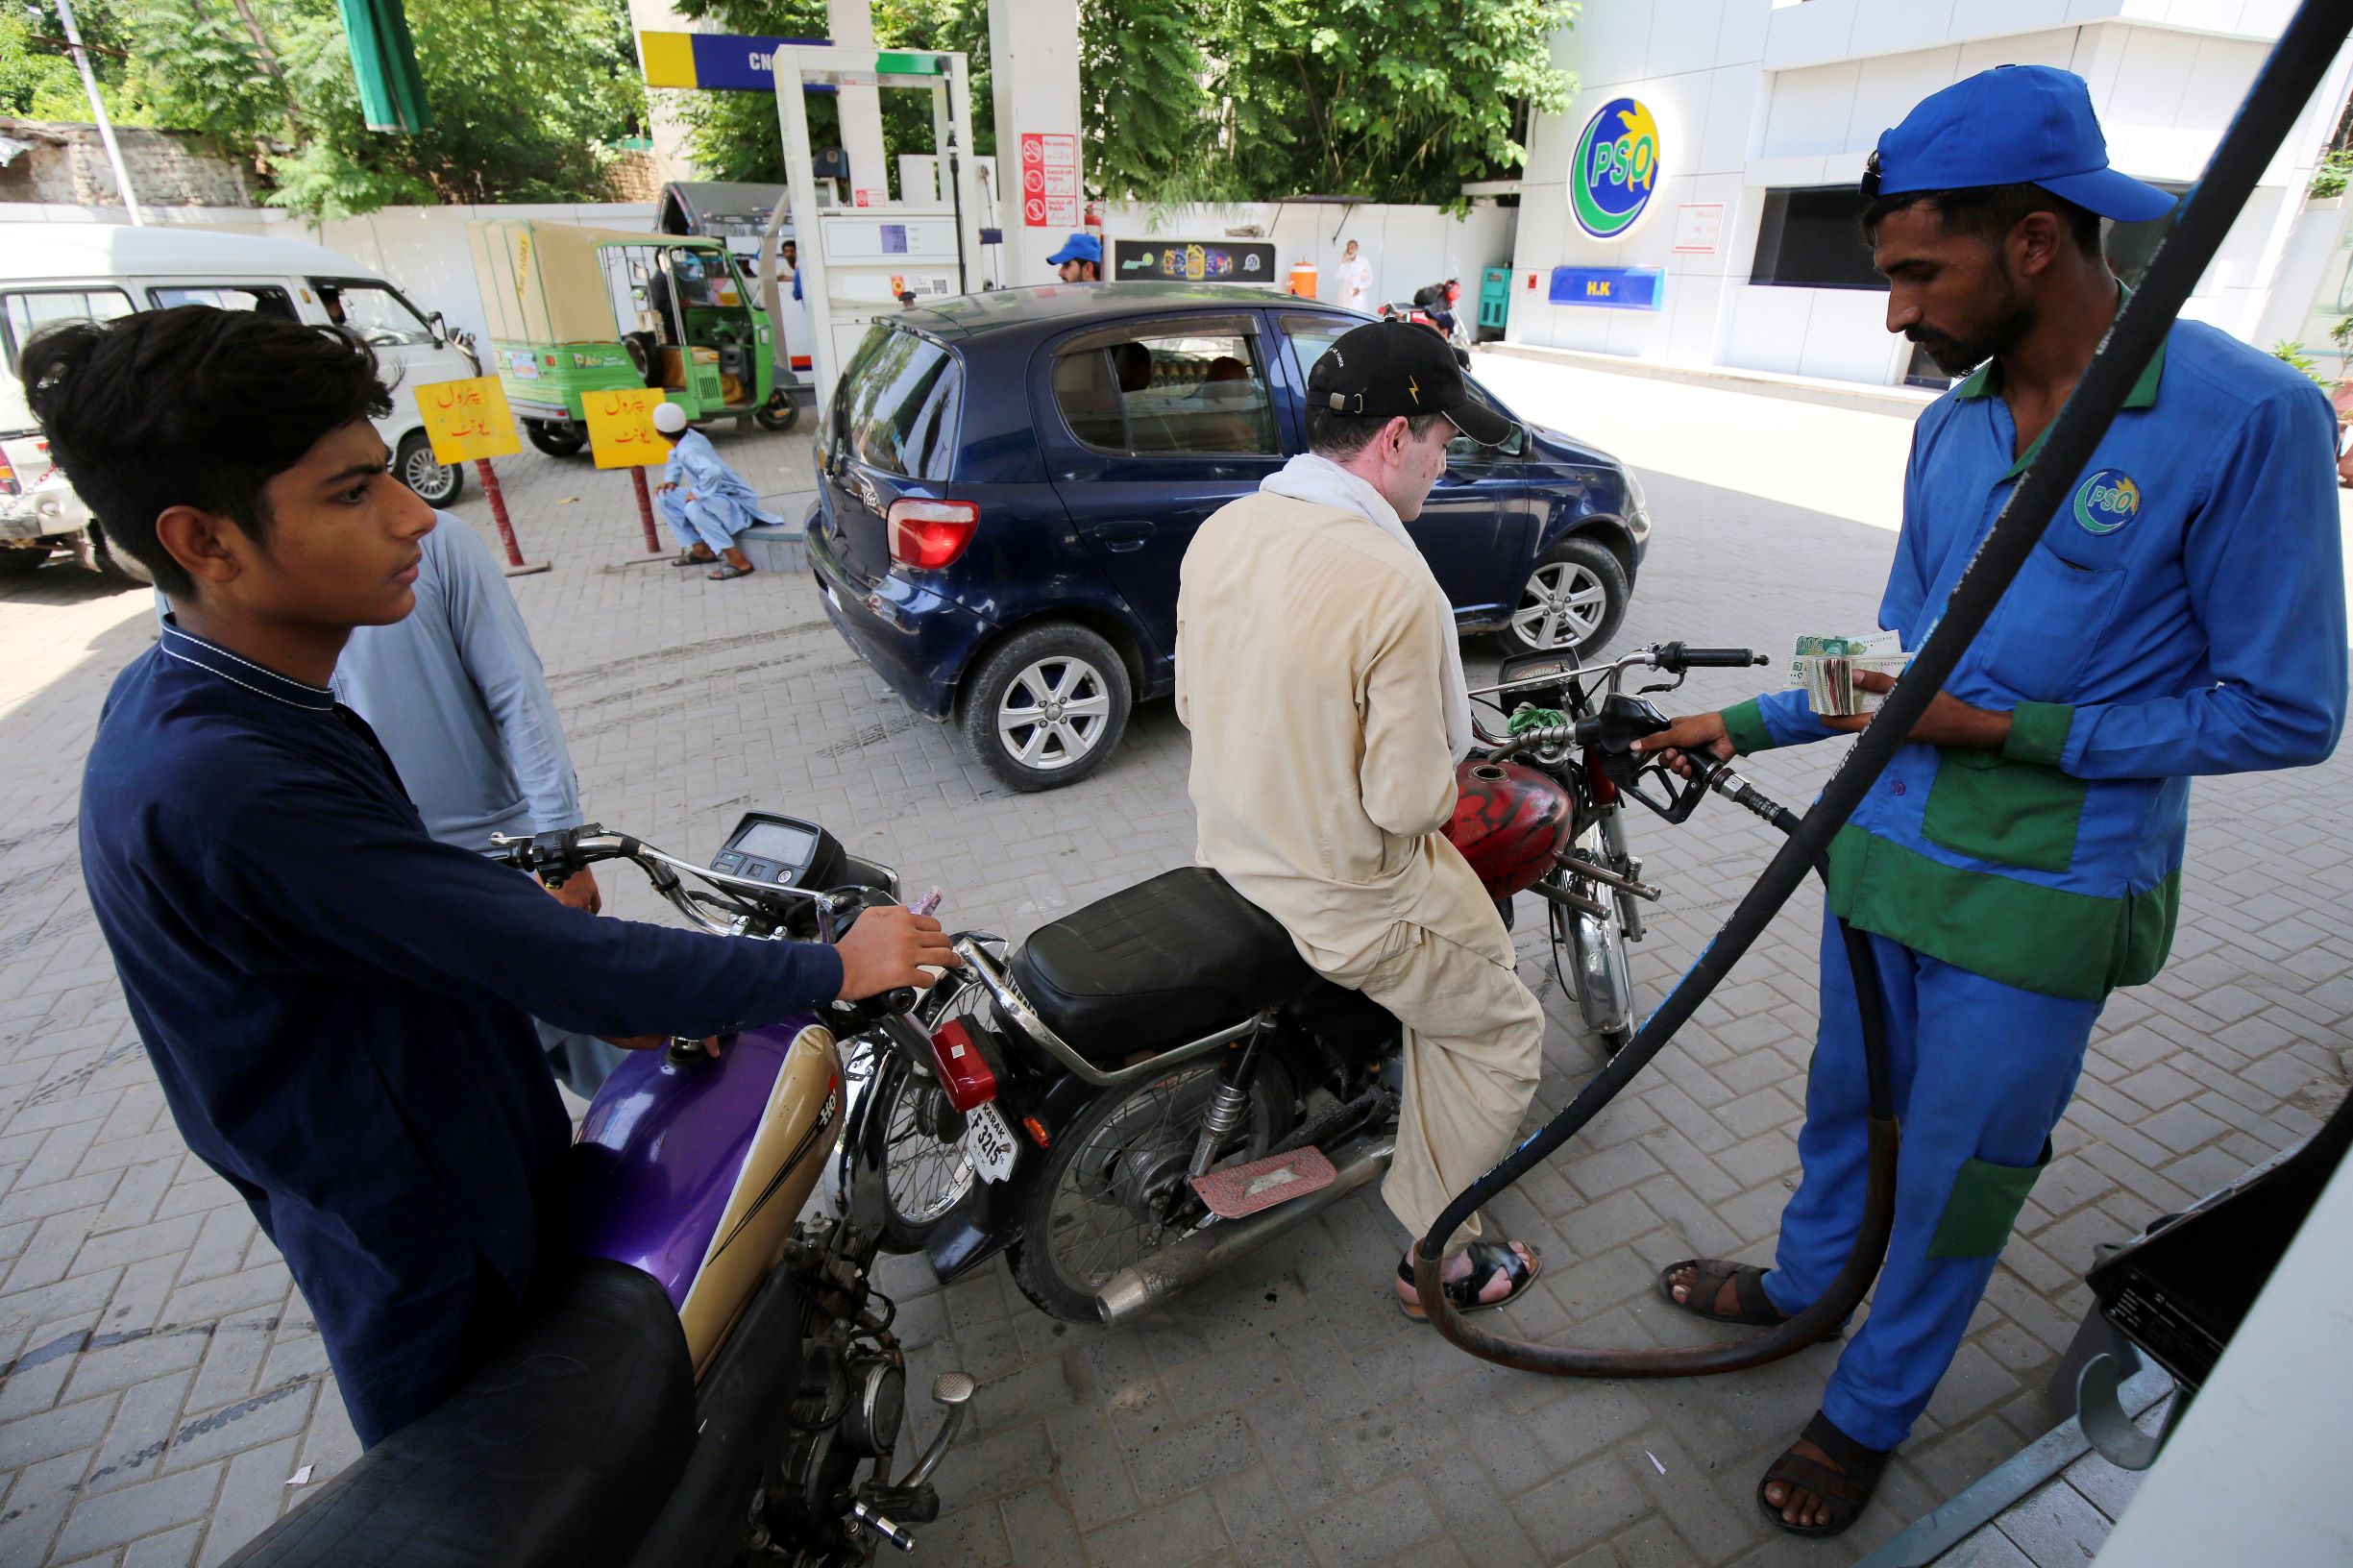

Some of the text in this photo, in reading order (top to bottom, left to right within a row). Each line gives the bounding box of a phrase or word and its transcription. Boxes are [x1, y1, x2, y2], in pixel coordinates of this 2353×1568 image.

[748, 52, 772, 71] CN
[1590, 134, 1654, 188] PSO
[2087, 484, 2134, 514] PSO
[1796, 635, 1825, 651] 500
[982, 1103, 1006, 1139] KARAK
[978, 1124, 1002, 1166] 3215
